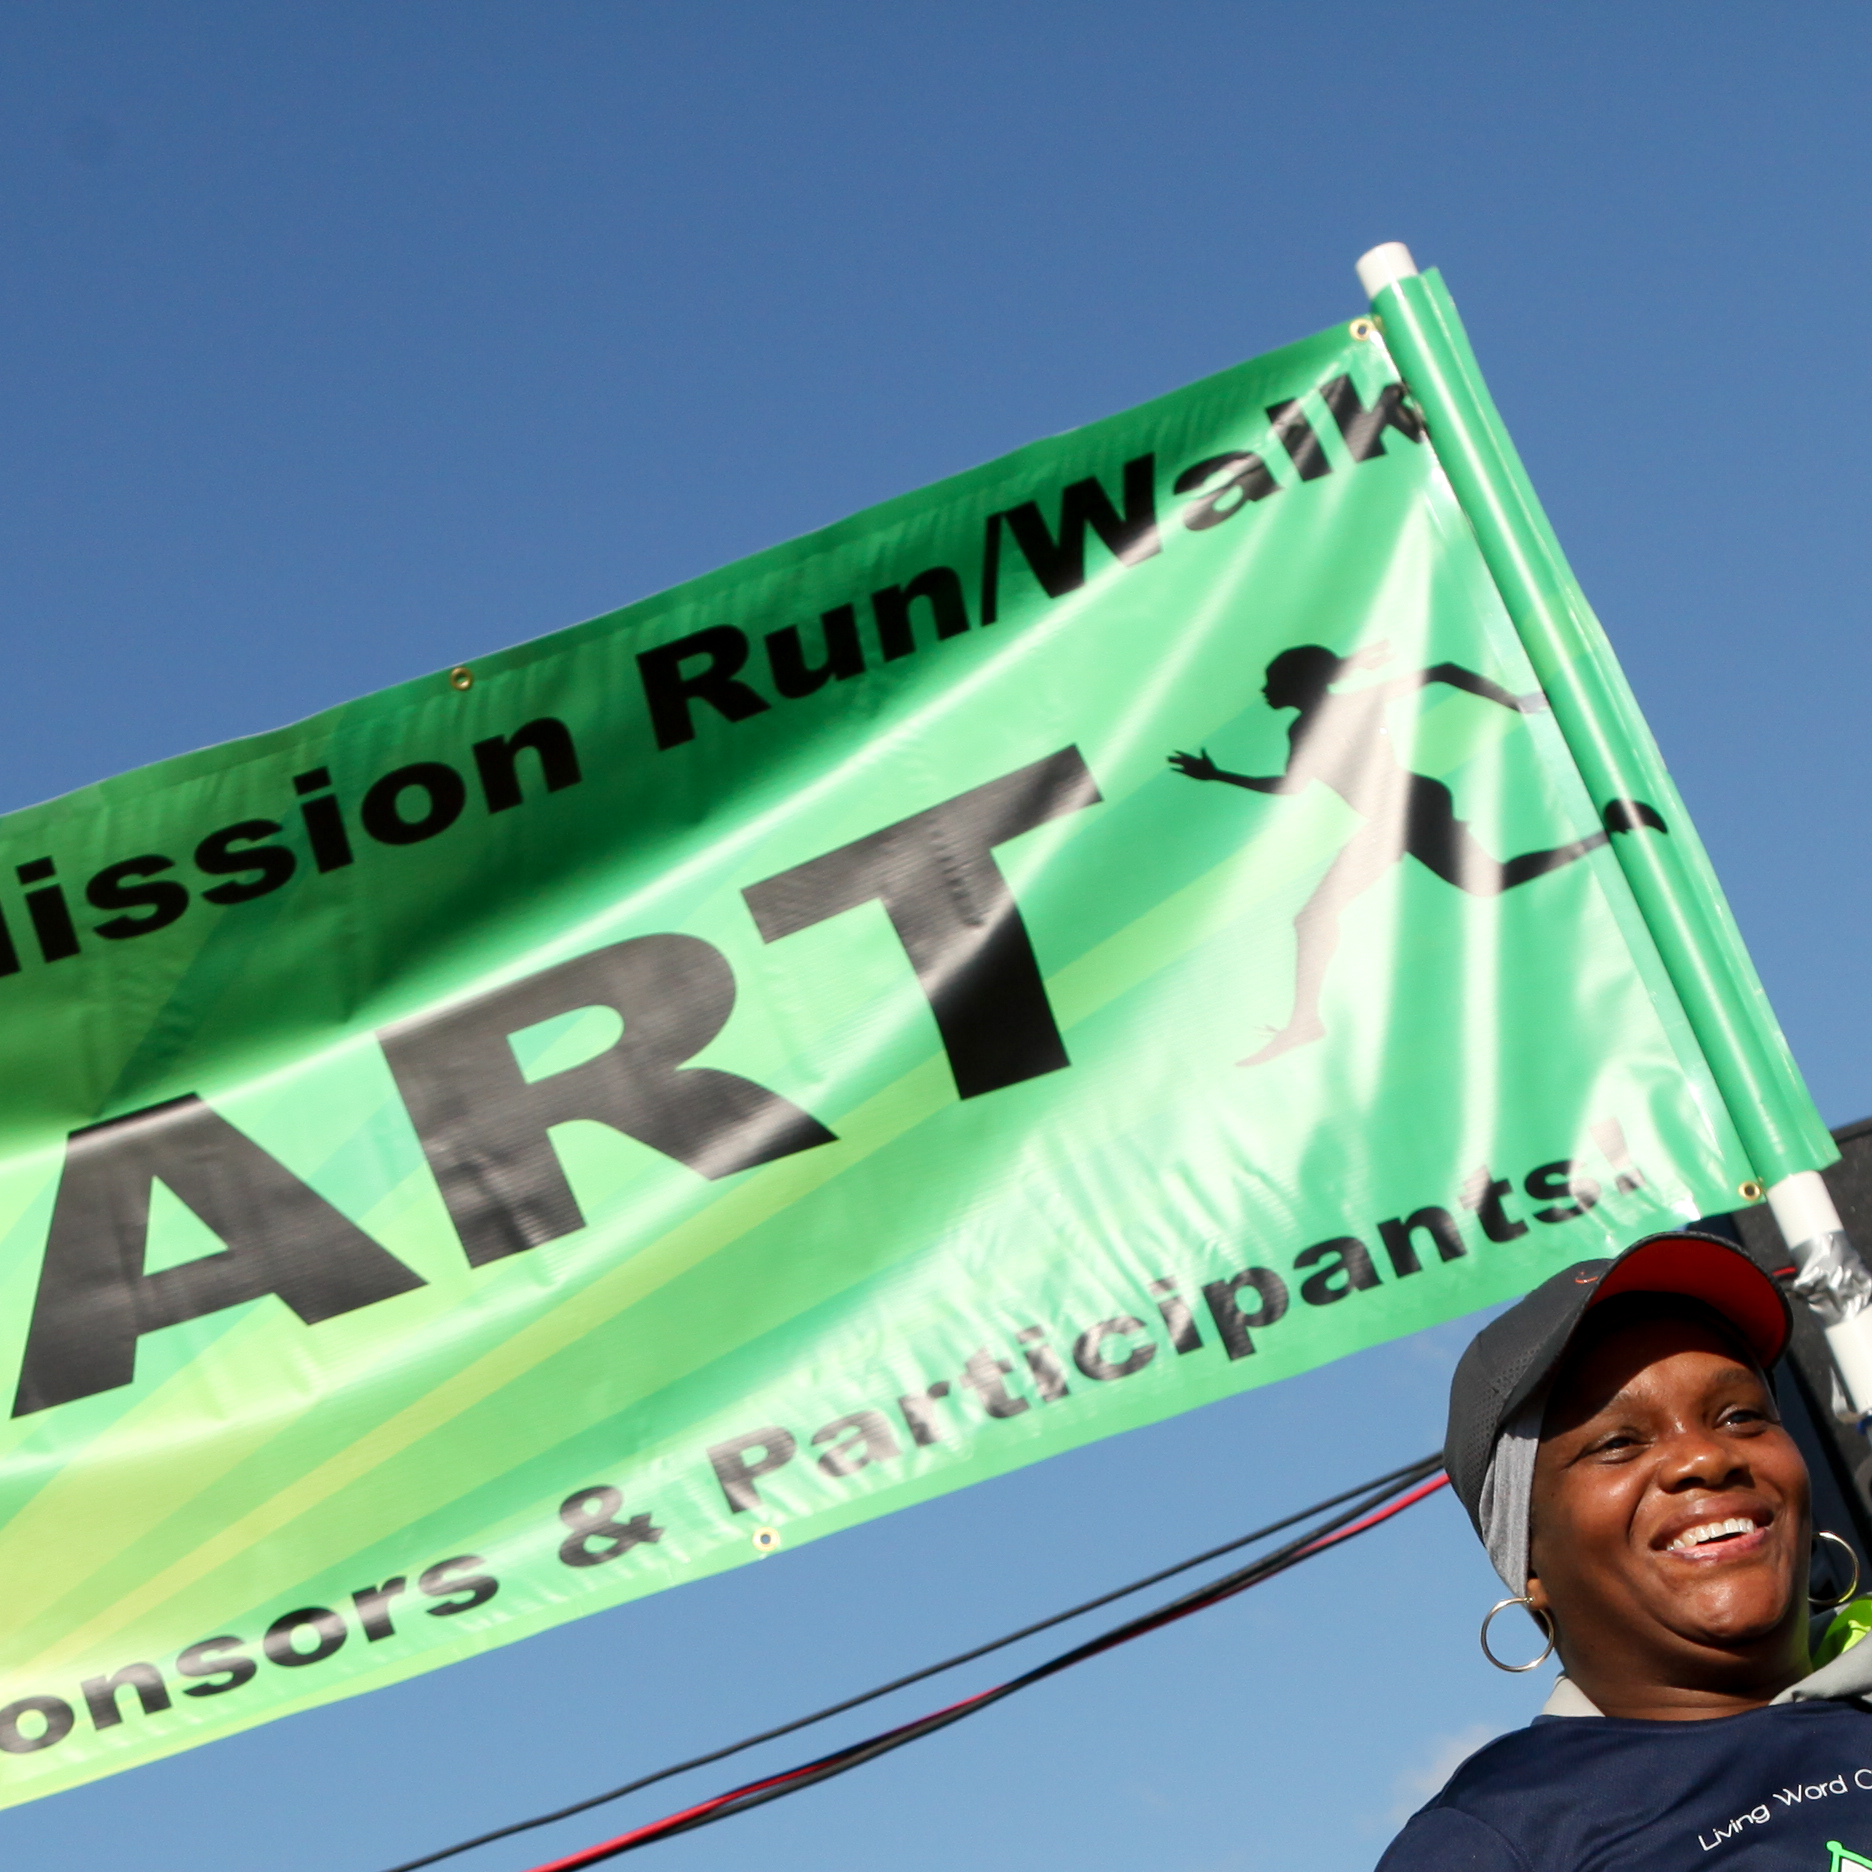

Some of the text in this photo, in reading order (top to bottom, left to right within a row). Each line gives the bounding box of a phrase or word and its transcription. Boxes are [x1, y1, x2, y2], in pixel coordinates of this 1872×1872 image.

[636, 370, 1430, 752] Run/Walk
[556, 1483, 667, 1570] &
[705, 1118, 1645, 1514] Participants!
[1698, 1804, 1771, 1851] Living
[1773, 1775, 1848, 1806] Word
